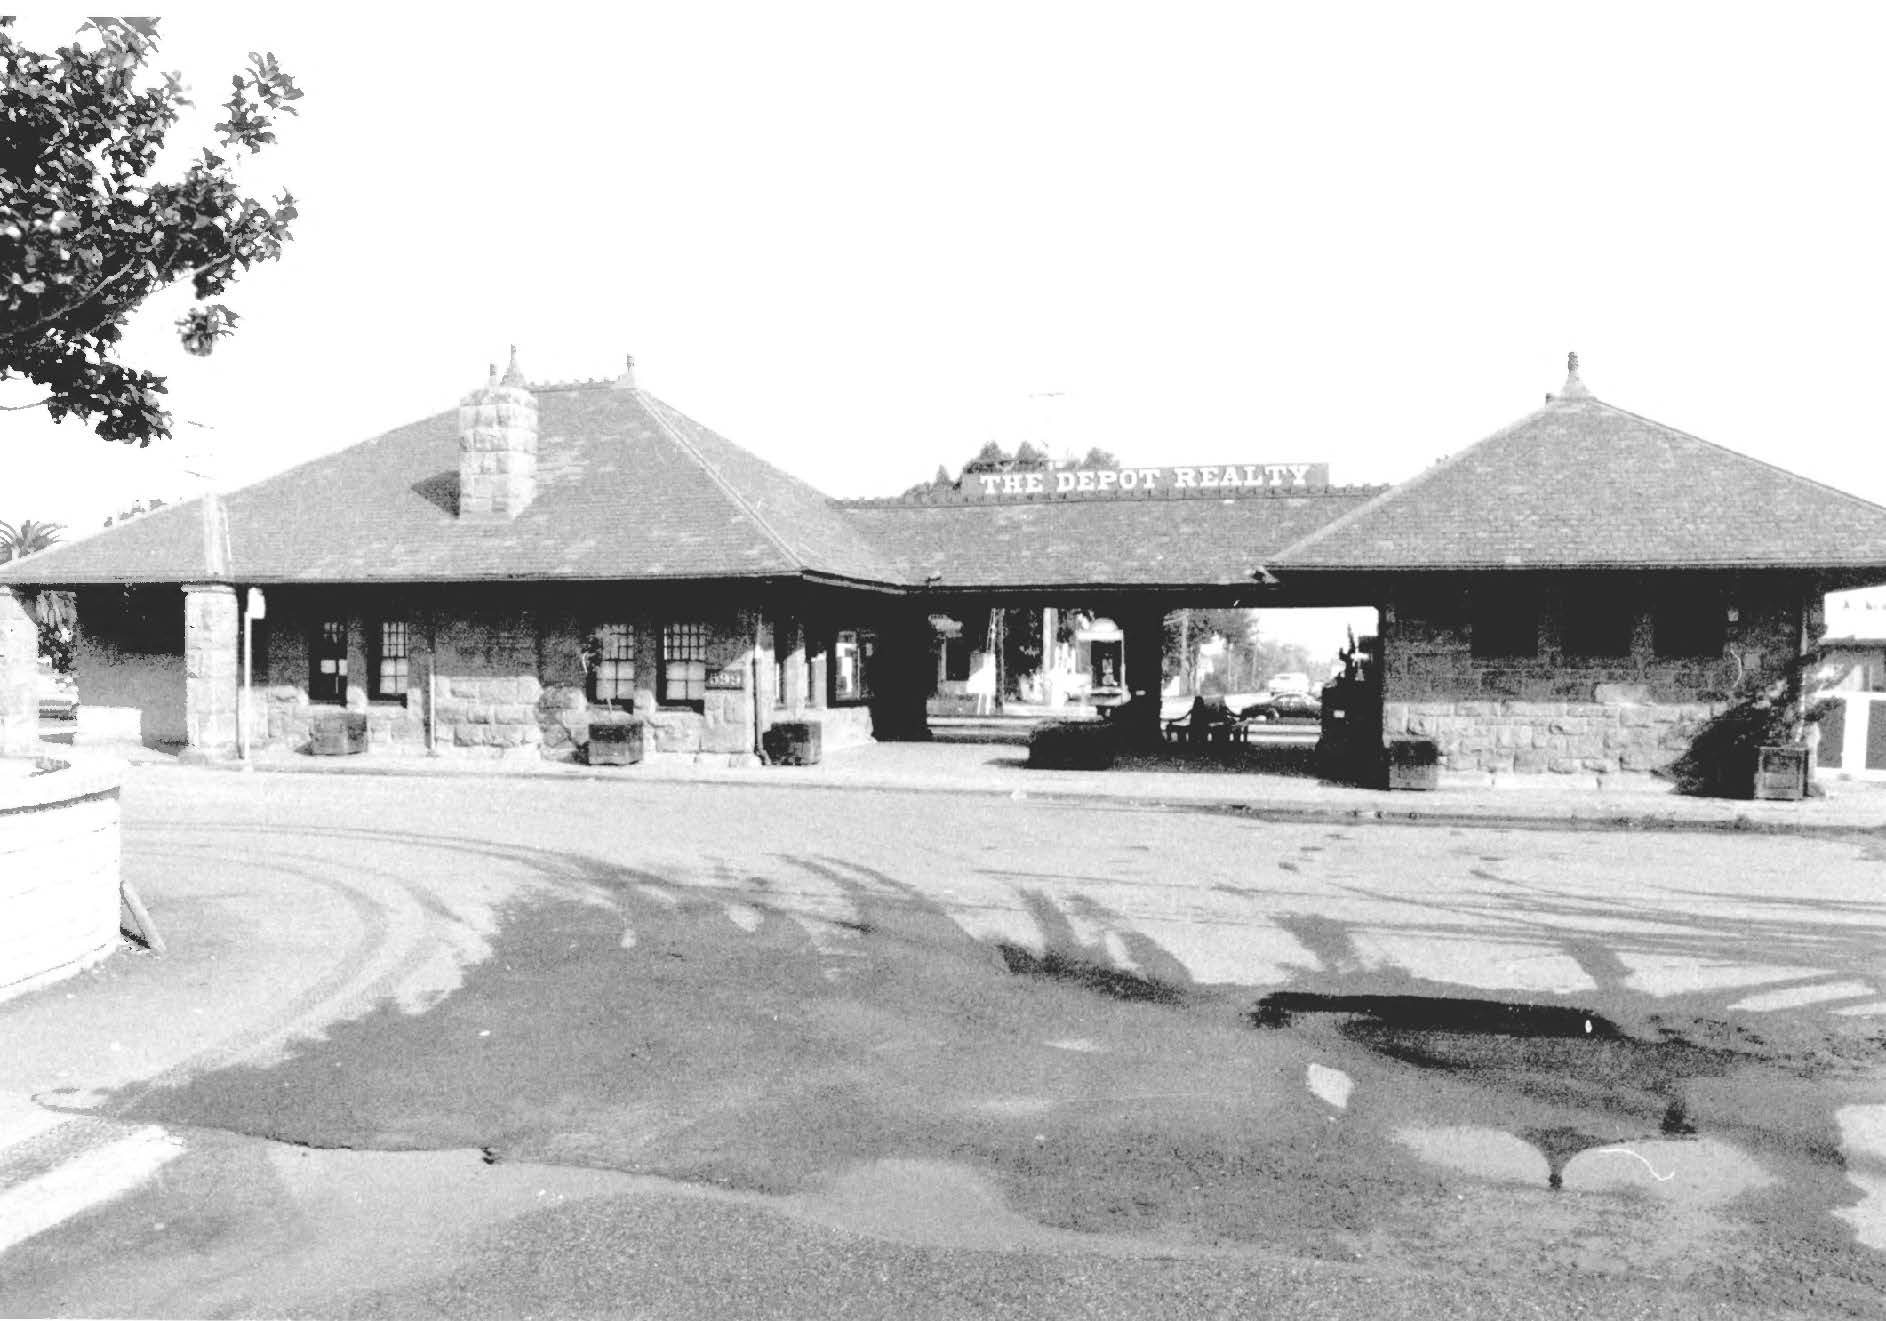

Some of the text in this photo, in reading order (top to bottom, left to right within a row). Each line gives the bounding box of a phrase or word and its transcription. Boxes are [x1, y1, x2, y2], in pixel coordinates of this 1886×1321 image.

[979, 464, 1310, 494] THE DEPOT REALTY
